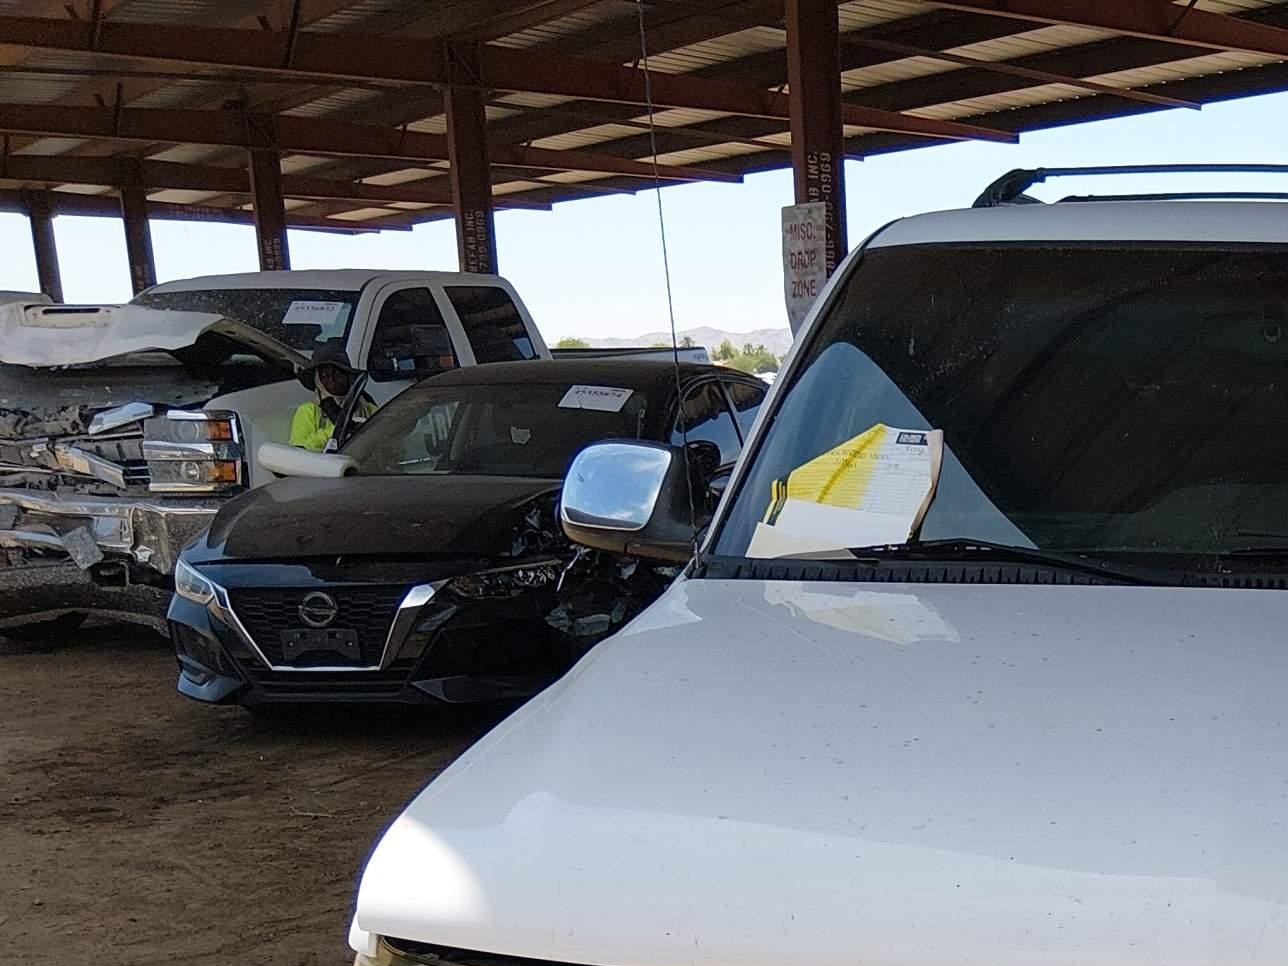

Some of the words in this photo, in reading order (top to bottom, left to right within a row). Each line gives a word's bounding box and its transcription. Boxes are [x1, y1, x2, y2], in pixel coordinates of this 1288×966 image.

[807, 151, 819, 179] INC.
[789, 222, 816, 241] MISC.
[790, 252, 817, 270] DROP
[792, 279, 817, 298] ZONE
